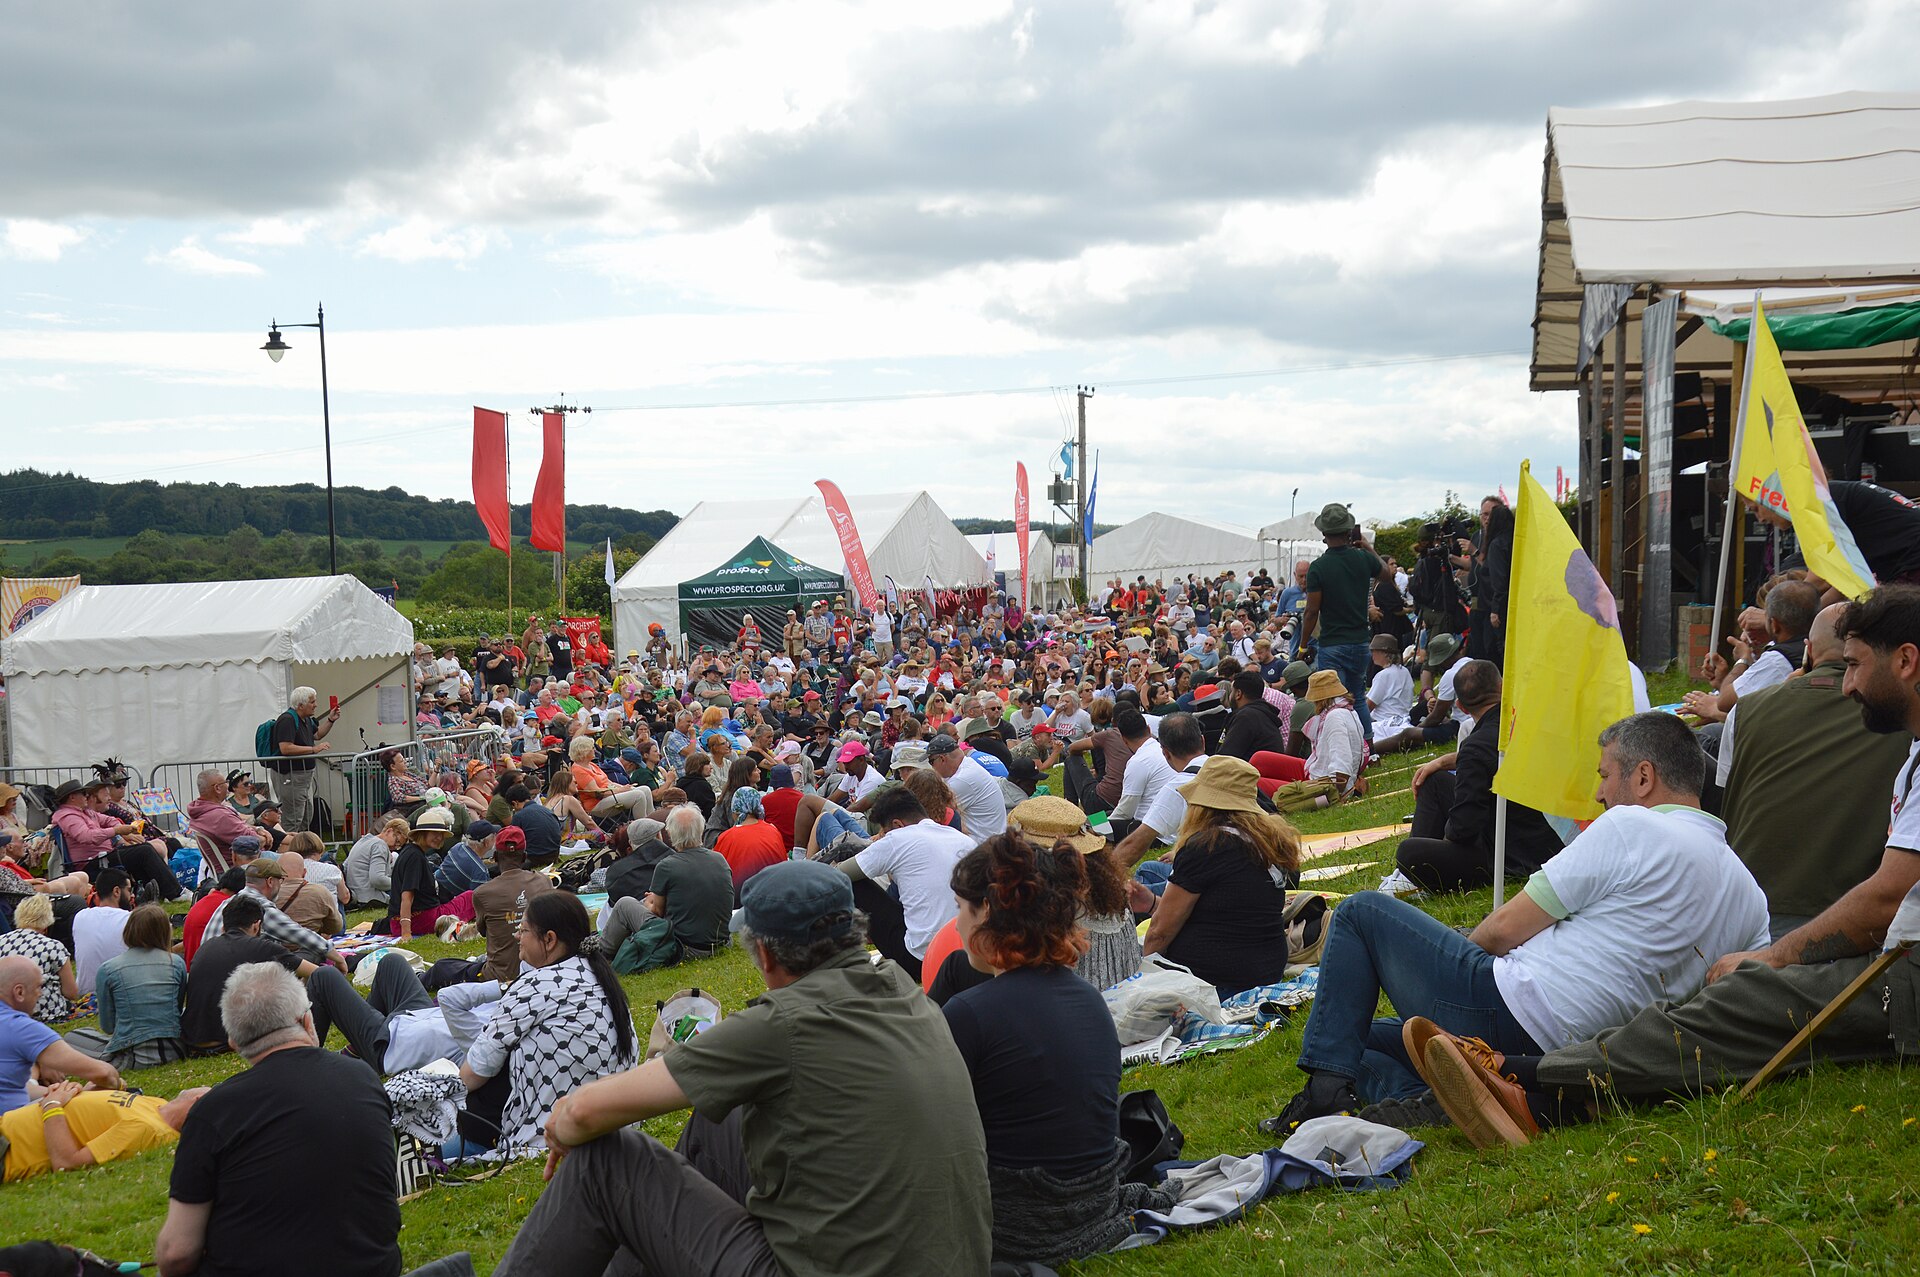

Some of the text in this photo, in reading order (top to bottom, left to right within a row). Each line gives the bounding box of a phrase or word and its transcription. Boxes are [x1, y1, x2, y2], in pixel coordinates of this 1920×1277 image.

[716, 566, 770, 576] prospect
[34, 586, 49, 596] CWU
[693, 584, 786, 595] WWW.PROSPECT.ORG.UK
